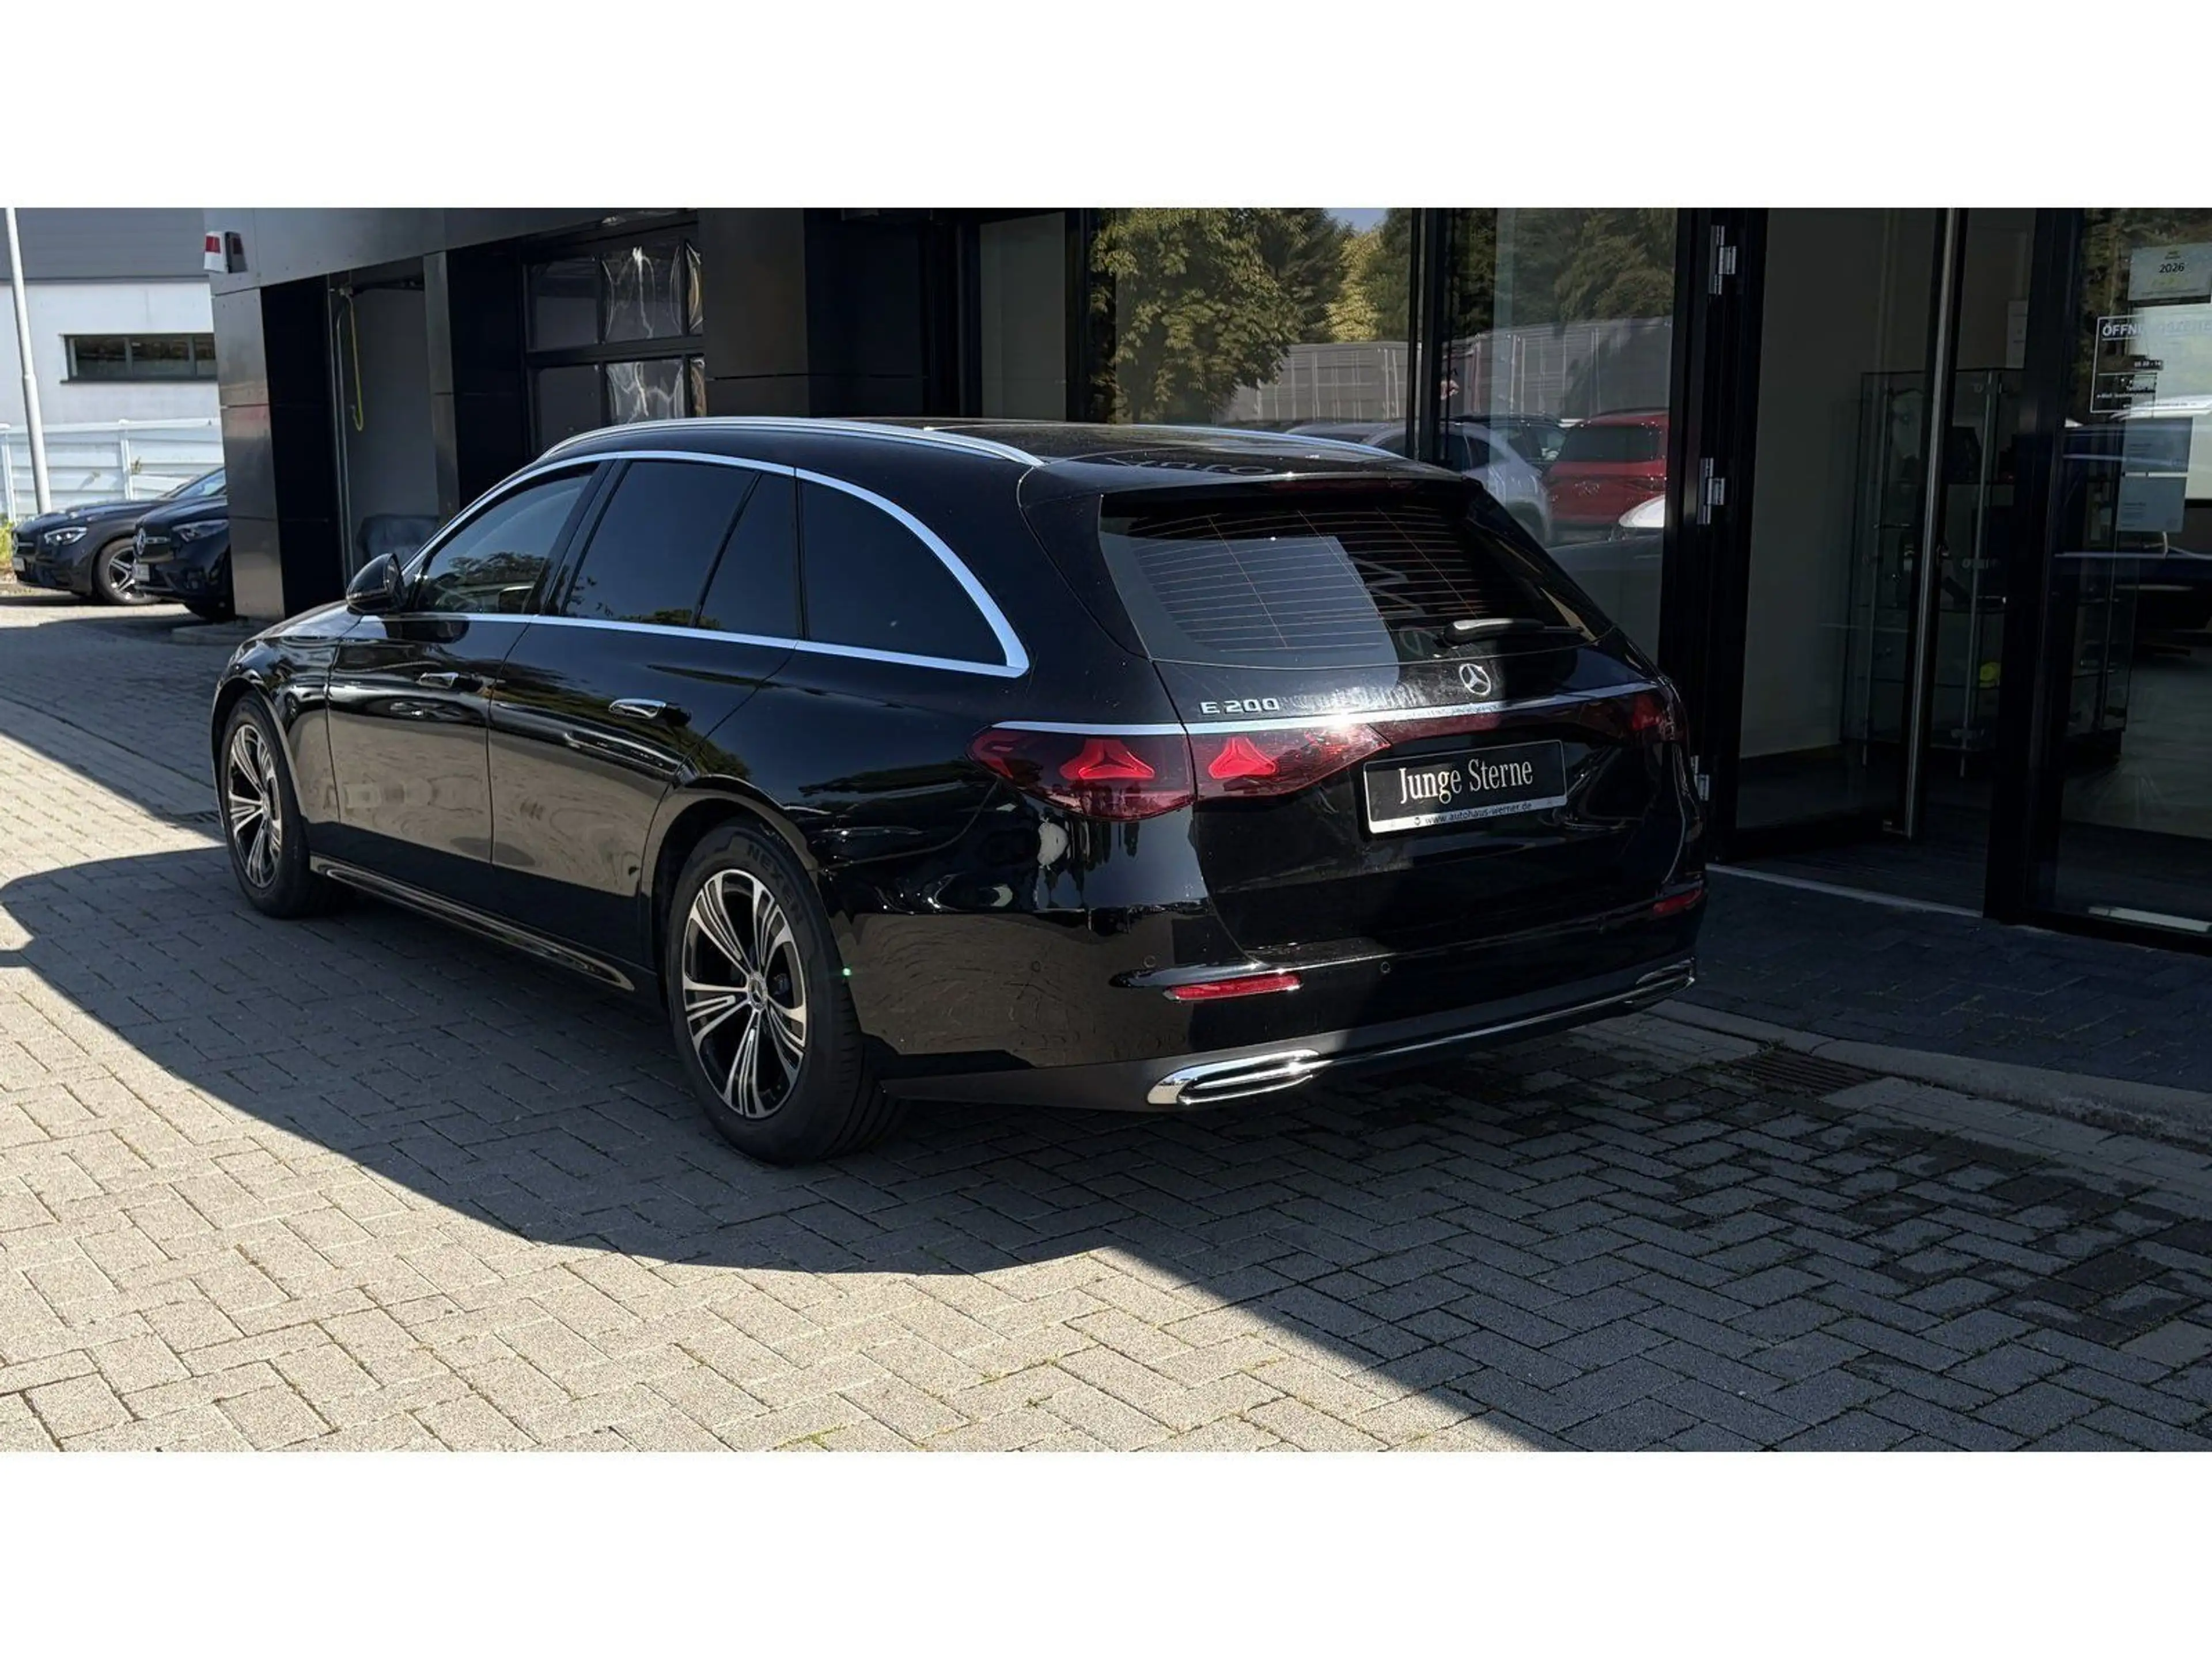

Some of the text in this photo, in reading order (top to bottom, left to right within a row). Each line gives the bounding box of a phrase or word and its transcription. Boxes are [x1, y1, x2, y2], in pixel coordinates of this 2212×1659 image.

[2158, 263, 2185, 274] 2026
[1199, 698, 1279, 715] E 200
[1399, 758, 1533, 804] Junge Sterne
[1425, 801, 1532, 825] www.autohaus-werner.de
